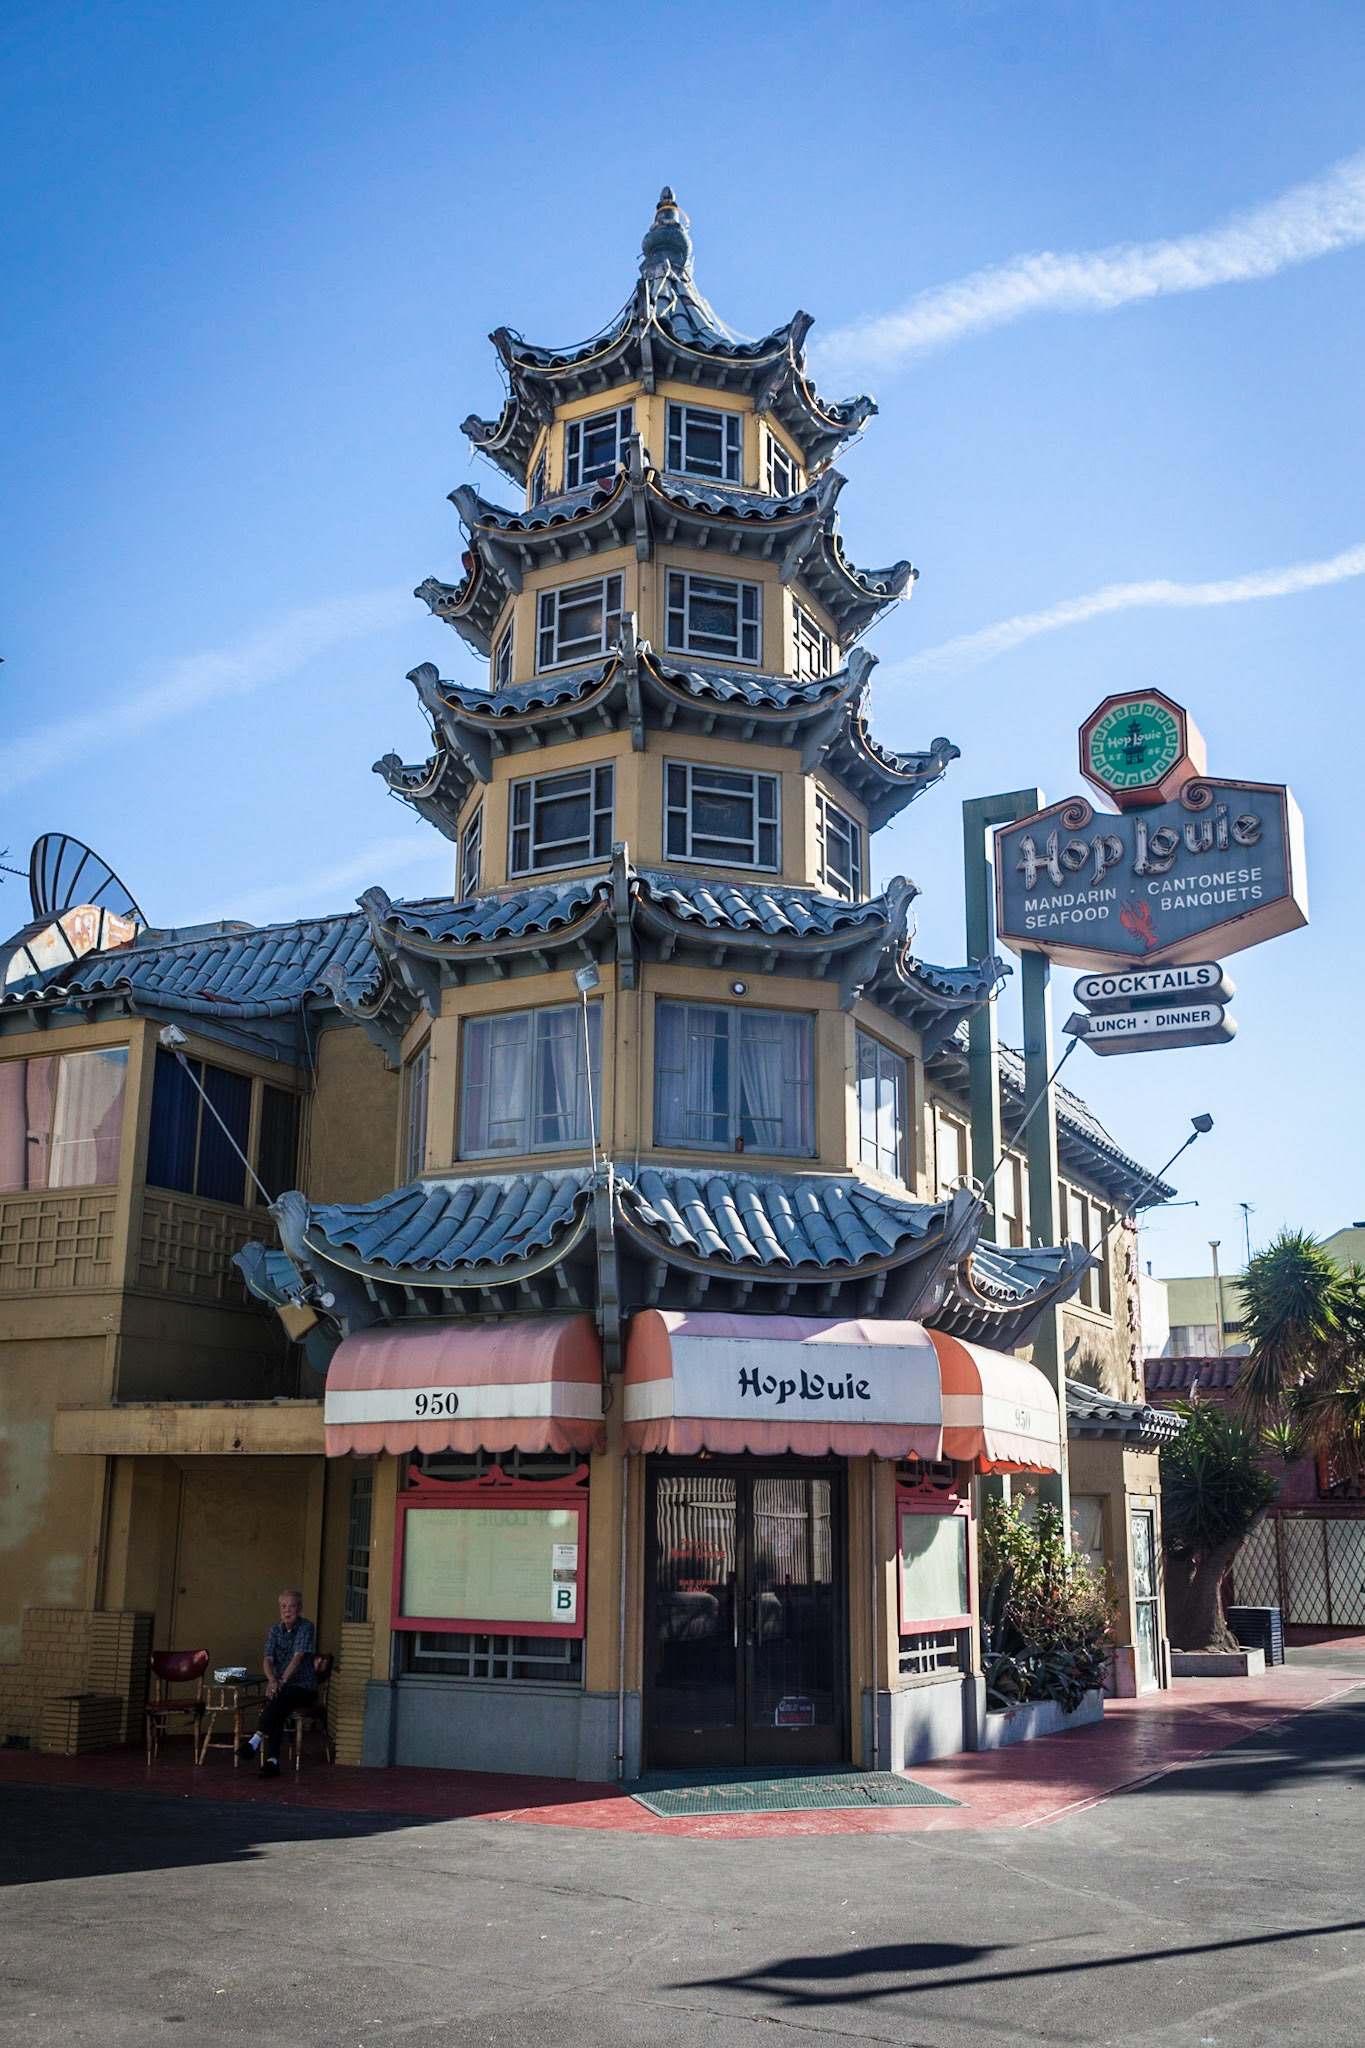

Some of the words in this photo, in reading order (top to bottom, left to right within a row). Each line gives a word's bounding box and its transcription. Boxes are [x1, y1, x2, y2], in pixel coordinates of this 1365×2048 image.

[1107, 736, 1131, 748] Hop
[1133, 730, 1162, 746] Louie
[1016, 829, 1124, 892] Hop
[1132, 803, 1263, 877] Louie
[1025, 888, 1117, 912] MANDARIN
[1147, 867, 1263, 895] CANTONESE
[1025, 906, 1110, 930] SEAFOOD
[1161, 885, 1263, 911] BANQUETS
[1086, 968, 1210, 997] COCKTAILS
[1087, 1018, 1137, 1033] LUNCH
[1156, 1010, 1211, 1027] DINNER
[738, 1366, 797, 1405] Hop
[798, 1368, 871, 1400] Louie
[414, 1392, 460, 1416] 950
[1014, 1408, 1031, 1431] 950
[557, 1589, 572, 1609] B
